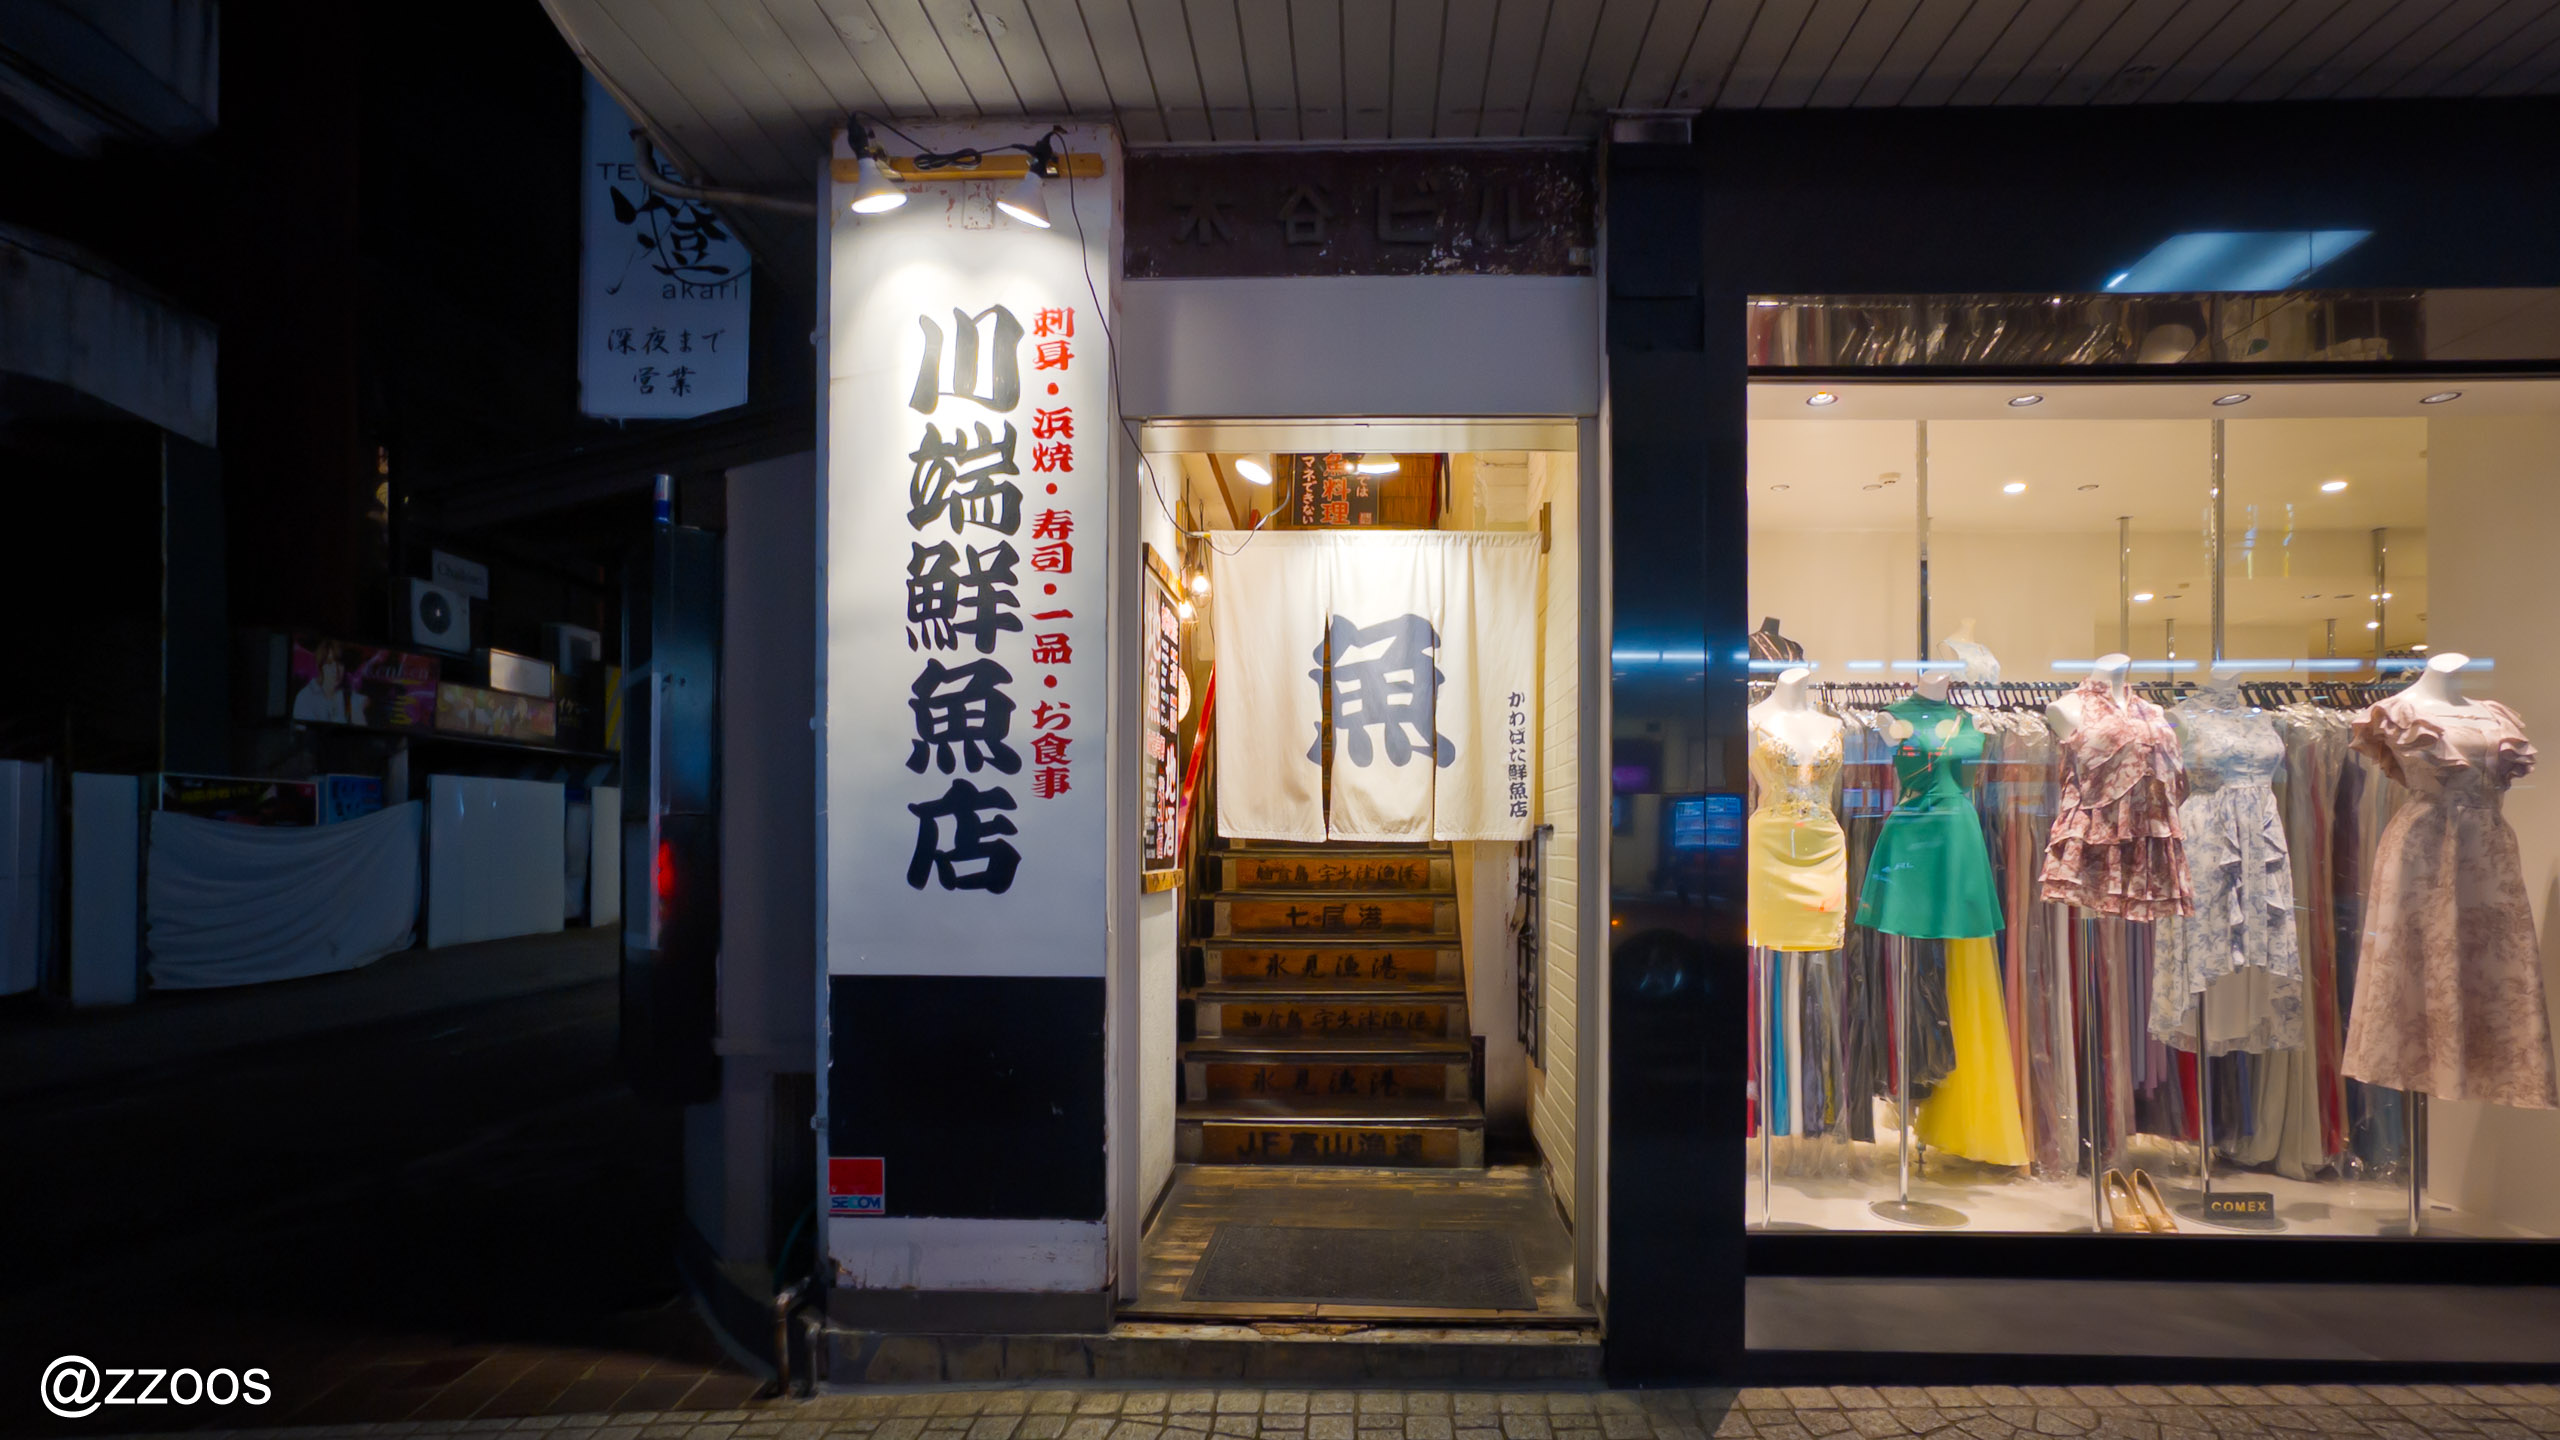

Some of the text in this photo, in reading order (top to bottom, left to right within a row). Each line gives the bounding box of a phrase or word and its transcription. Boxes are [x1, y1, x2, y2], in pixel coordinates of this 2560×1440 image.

[662, 280, 739, 299] akari
[607, 328, 726, 355] 深夜まで
[633, 366, 697, 398] 営業
[1301, 456, 1317, 525] マネできない
[906, 303, 1024, 894] 川端鮮魚店
[1306, 613, 1456, 769] 魚
[1508, 691, 1529, 818] かわばた鮮魚店
[831, 1196, 881, 1209] SECOM
[2211, 1201, 2267, 1212] COMEX
